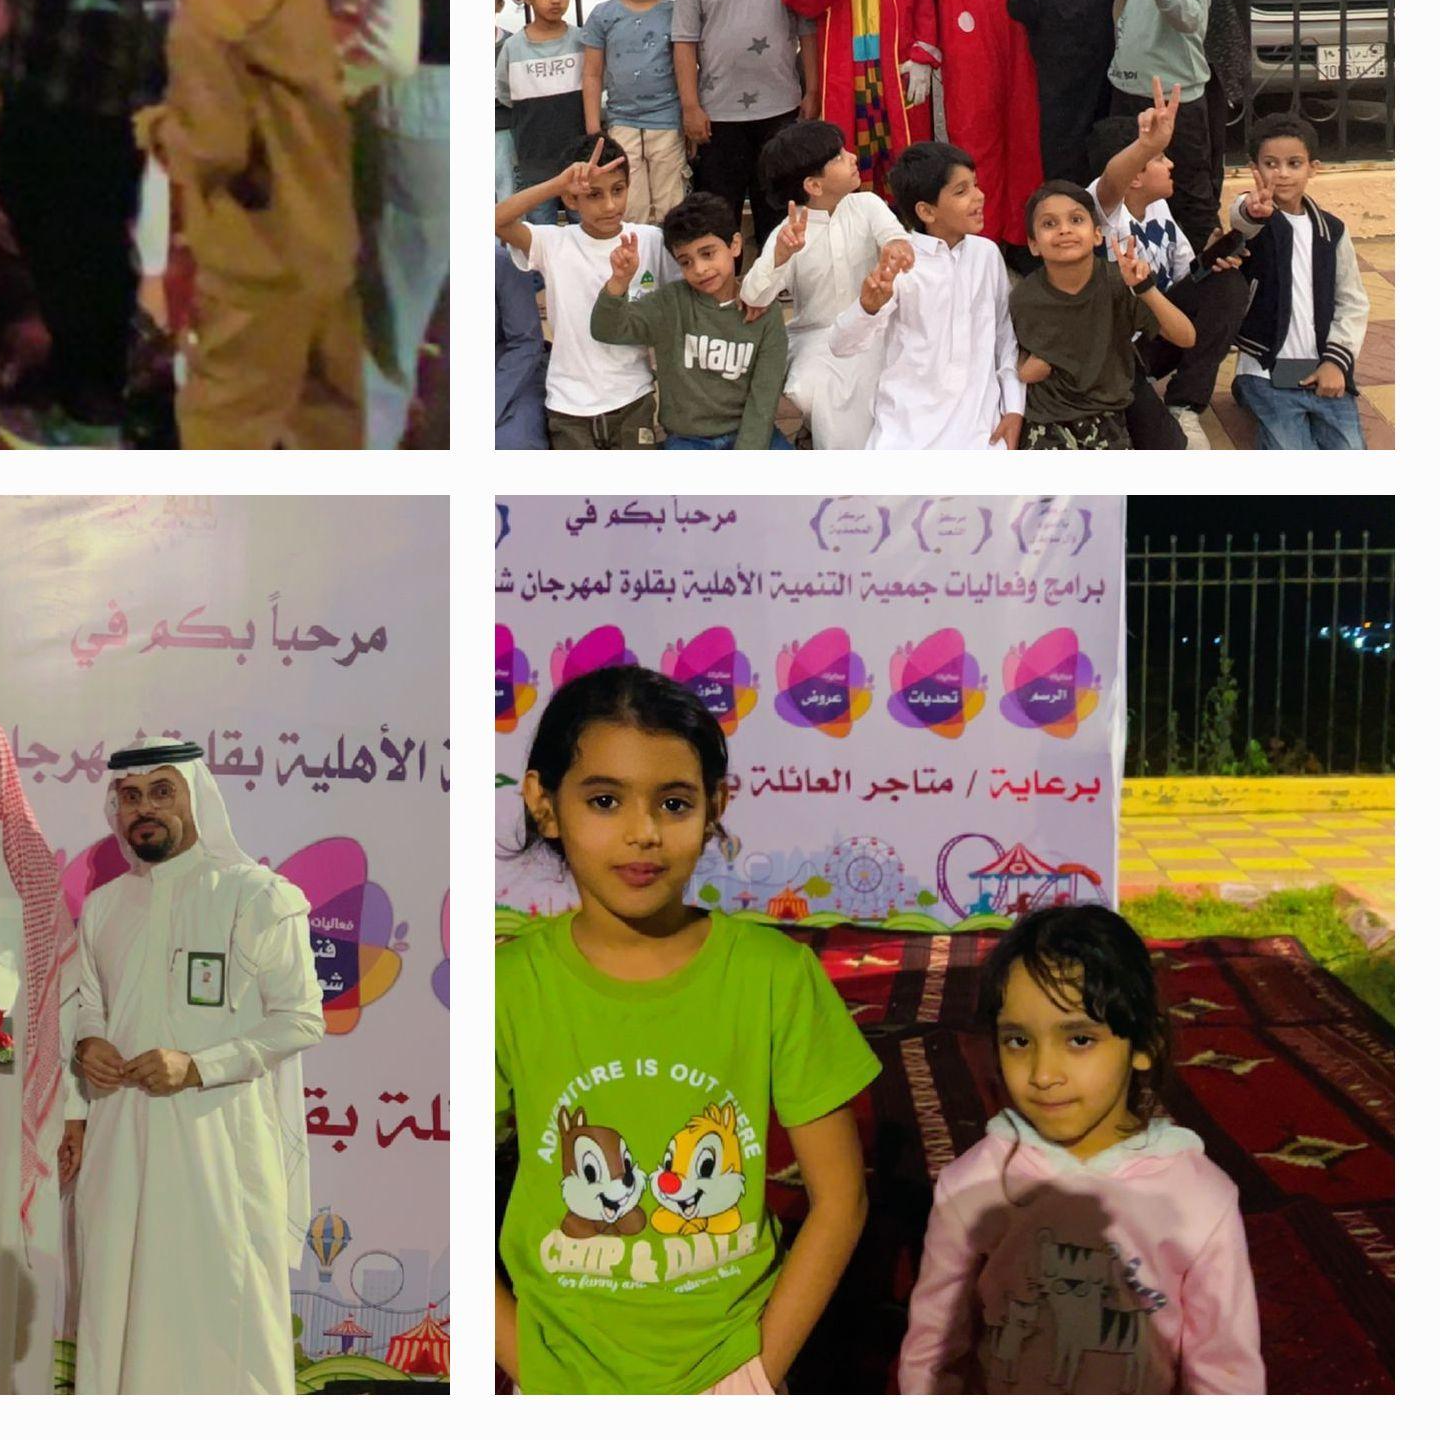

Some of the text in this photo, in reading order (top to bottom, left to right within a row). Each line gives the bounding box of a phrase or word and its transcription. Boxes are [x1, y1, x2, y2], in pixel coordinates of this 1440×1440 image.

[684, 333, 755, 381] Play!
[565, 497, 598, 537] في
[604, 500, 666, 533] بكم
[520, 569, 613, 602] لمهرجان
[619, 569, 677, 603] بقلوة
[682, 562, 763, 603] الأهلية
[769, 571, 852, 604] التنمية
[860, 571, 938, 605] جمعية
[944, 570, 1038, 605] وفعاليات
[1043, 572, 1106, 607] برامج
[70, 598, 129, 669] في
[138, 604, 256, 666] بكم
[800, 690, 843, 706] عروض
[908, 690, 960, 706] تحديات
[1028, 689, 1069, 703] الرسم
[276, 723, 427, 794] الأهلية
[751, 766, 852, 797] العائلة
[859, 767, 955, 802] متاجر
[989, 768, 1102, 803] برعاية
[636, 1058, 658, 1077] IS
[670, 1063, 719, 1093] OUT
[540, 1229, 626, 1276] CHIP
